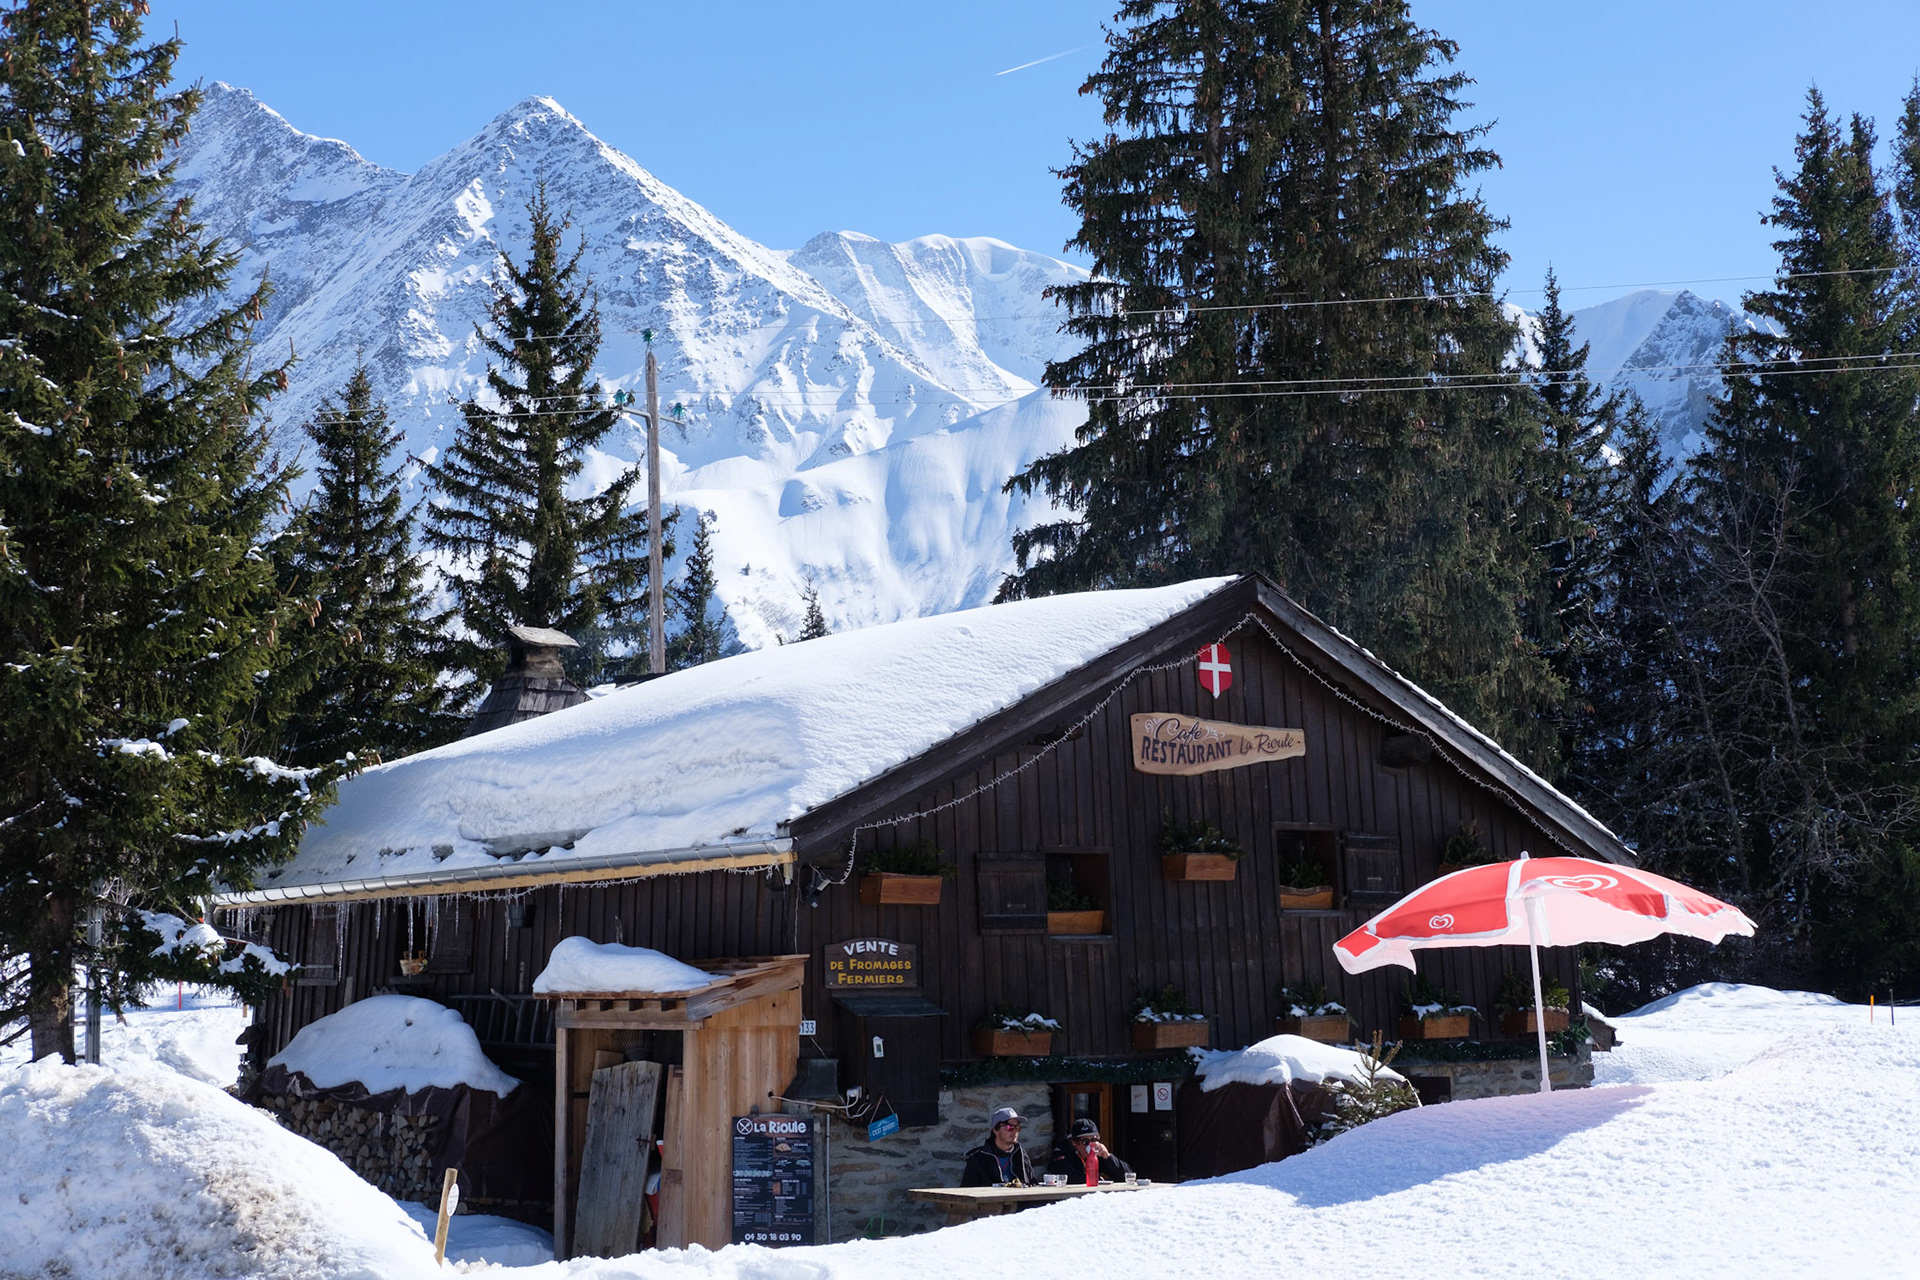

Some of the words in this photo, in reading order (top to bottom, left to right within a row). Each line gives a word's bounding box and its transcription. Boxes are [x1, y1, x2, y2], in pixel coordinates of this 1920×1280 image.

[1156, 718, 1203, 745] Café
[1141, 736, 1233, 764] RESTAURANT
[1239, 735, 1254, 754] La
[1255, 732, 1295, 755] Rioule
[843, 940, 899, 956] VENTE
[830, 961, 844, 971] DE
[849, 959, 912, 971] FROMAGES
[837, 972, 905, 985] FERMIERS
[799, 1022, 815, 1034] 133
[754, 1122, 767, 1133] La
[769, 1120, 807, 1134] Rioule
[744, 1233, 755, 1241] 04
[757, 1233, 768, 1241] 50
[769, 1233, 777, 1241] 18
[779, 1233, 789, 1241] 03
[791, 1233, 802, 1241] 90
